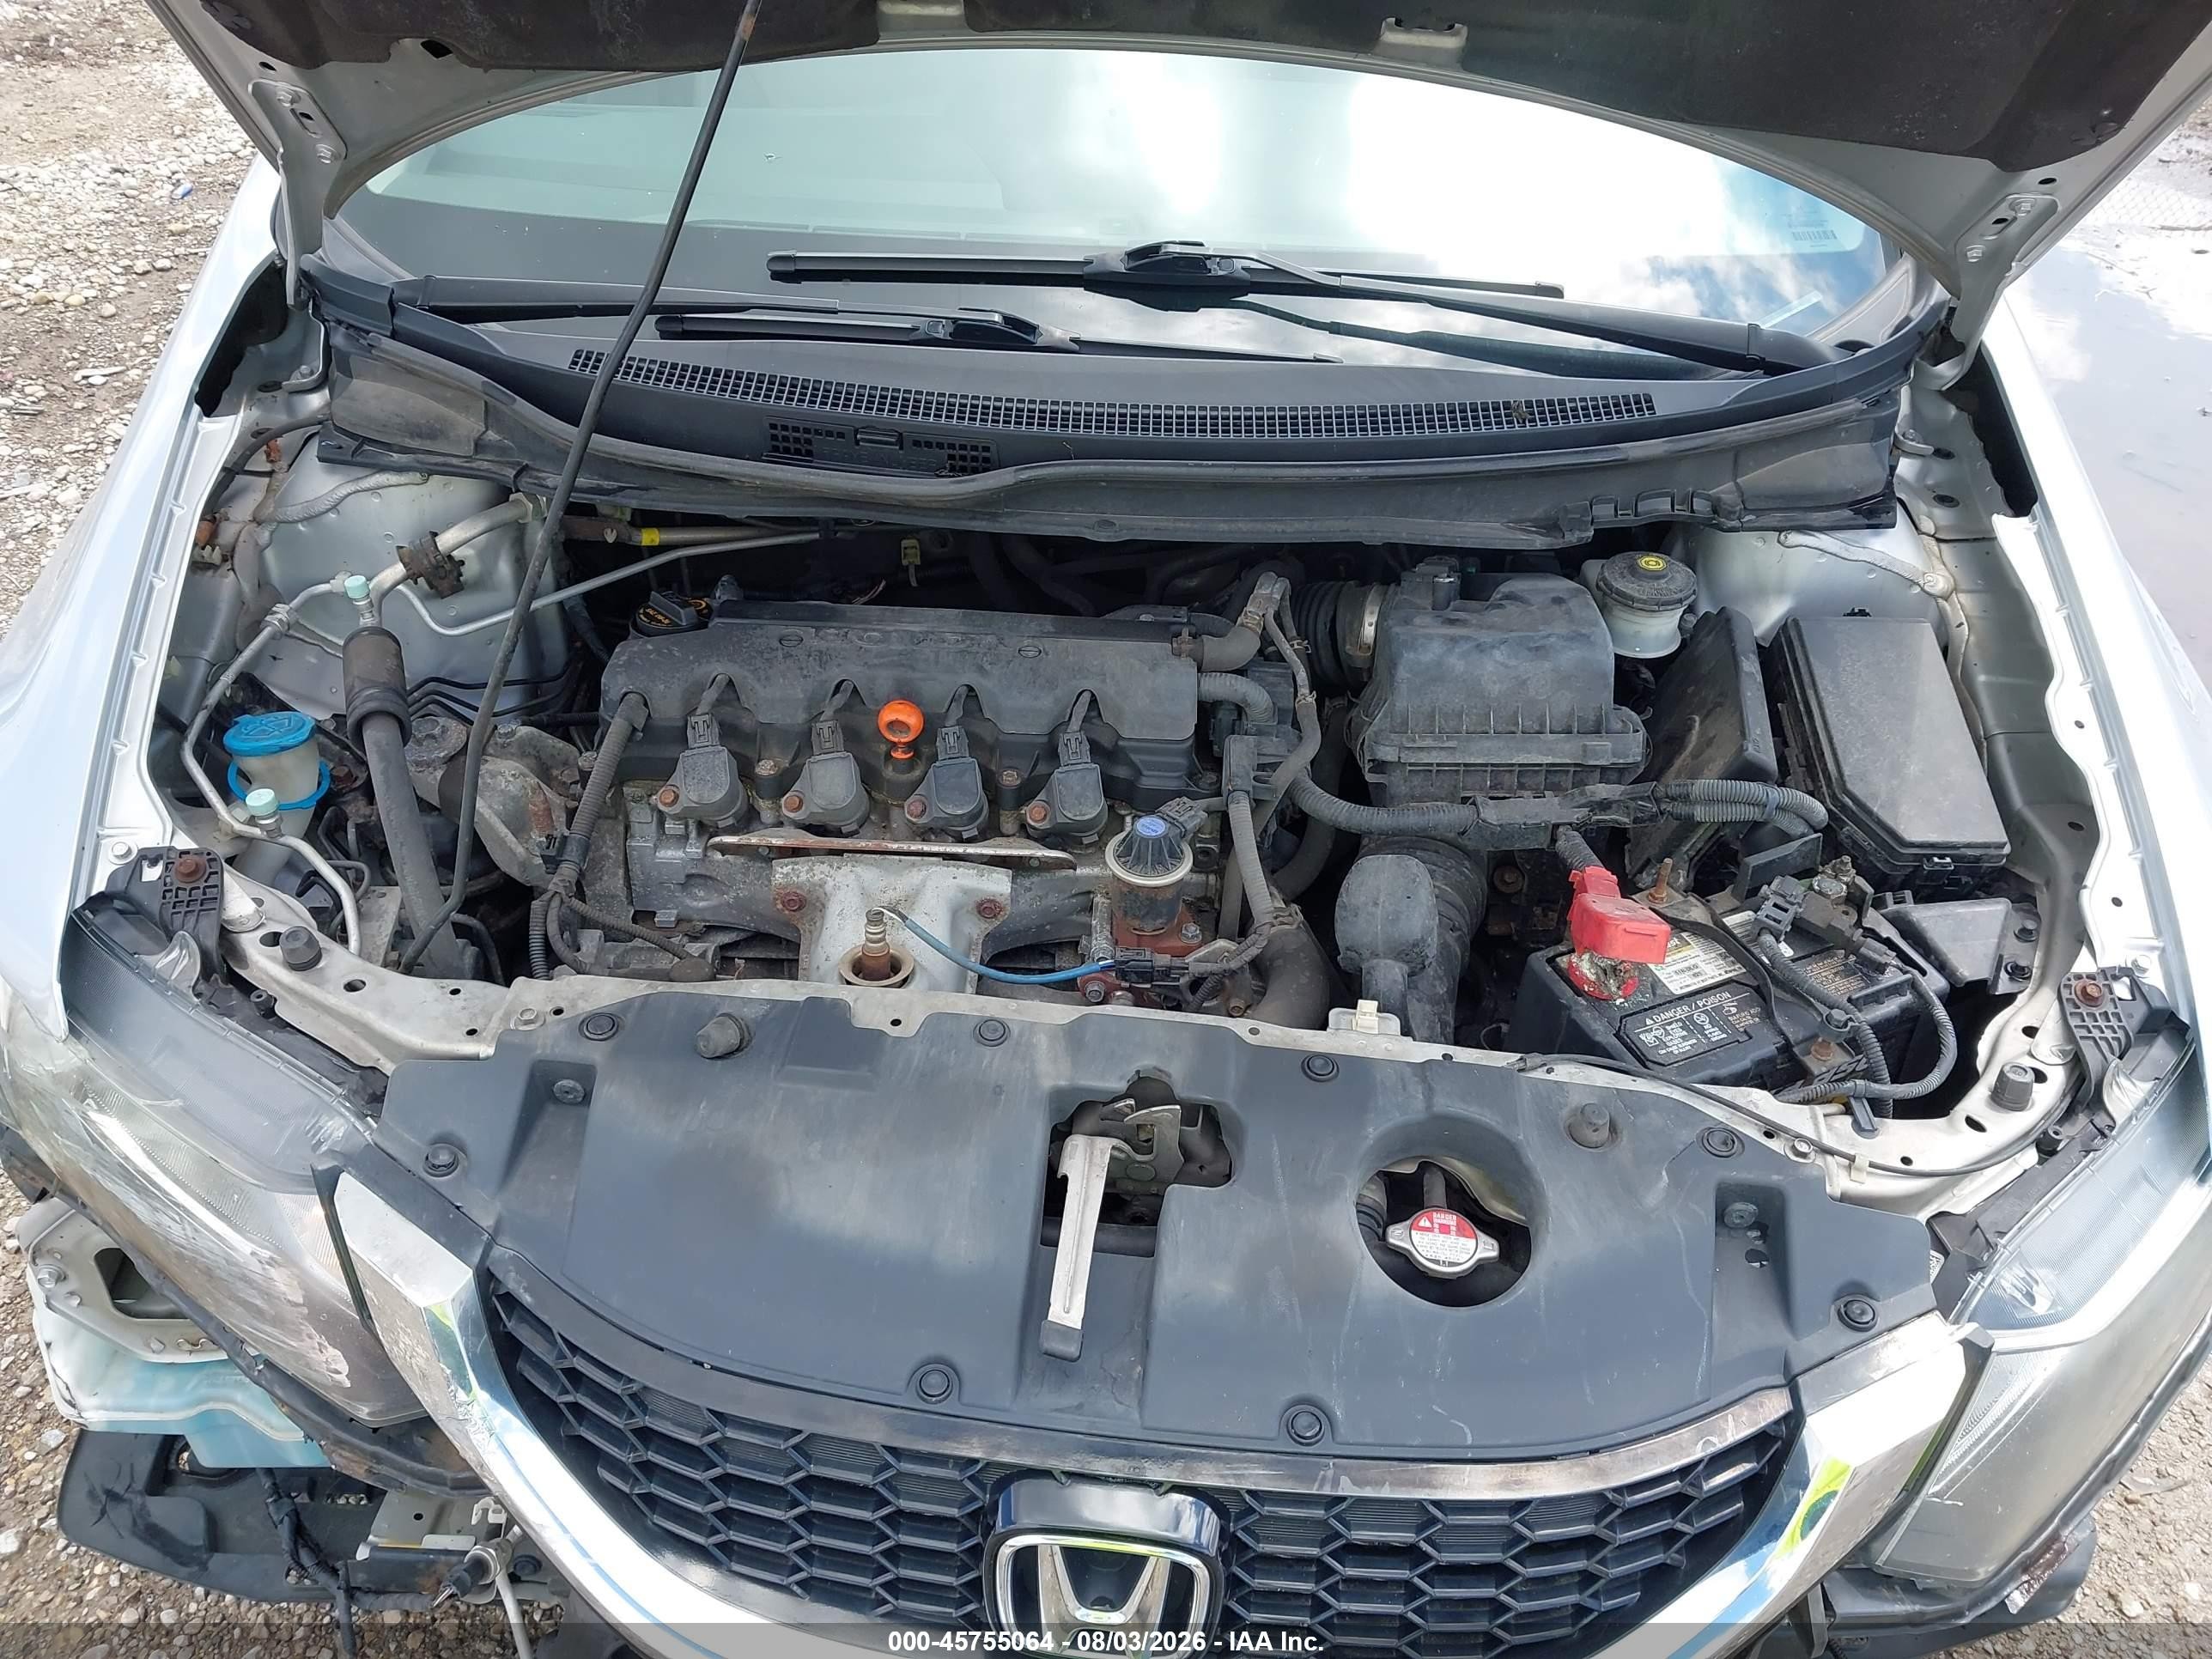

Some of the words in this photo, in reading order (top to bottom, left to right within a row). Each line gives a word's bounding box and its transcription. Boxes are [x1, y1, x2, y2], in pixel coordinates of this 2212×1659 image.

[1652, 1005, 1692, 1023] DANGER
[1696, 991, 1732, 1008] POISON
[1432, 1212, 1457, 1220] DANGER
